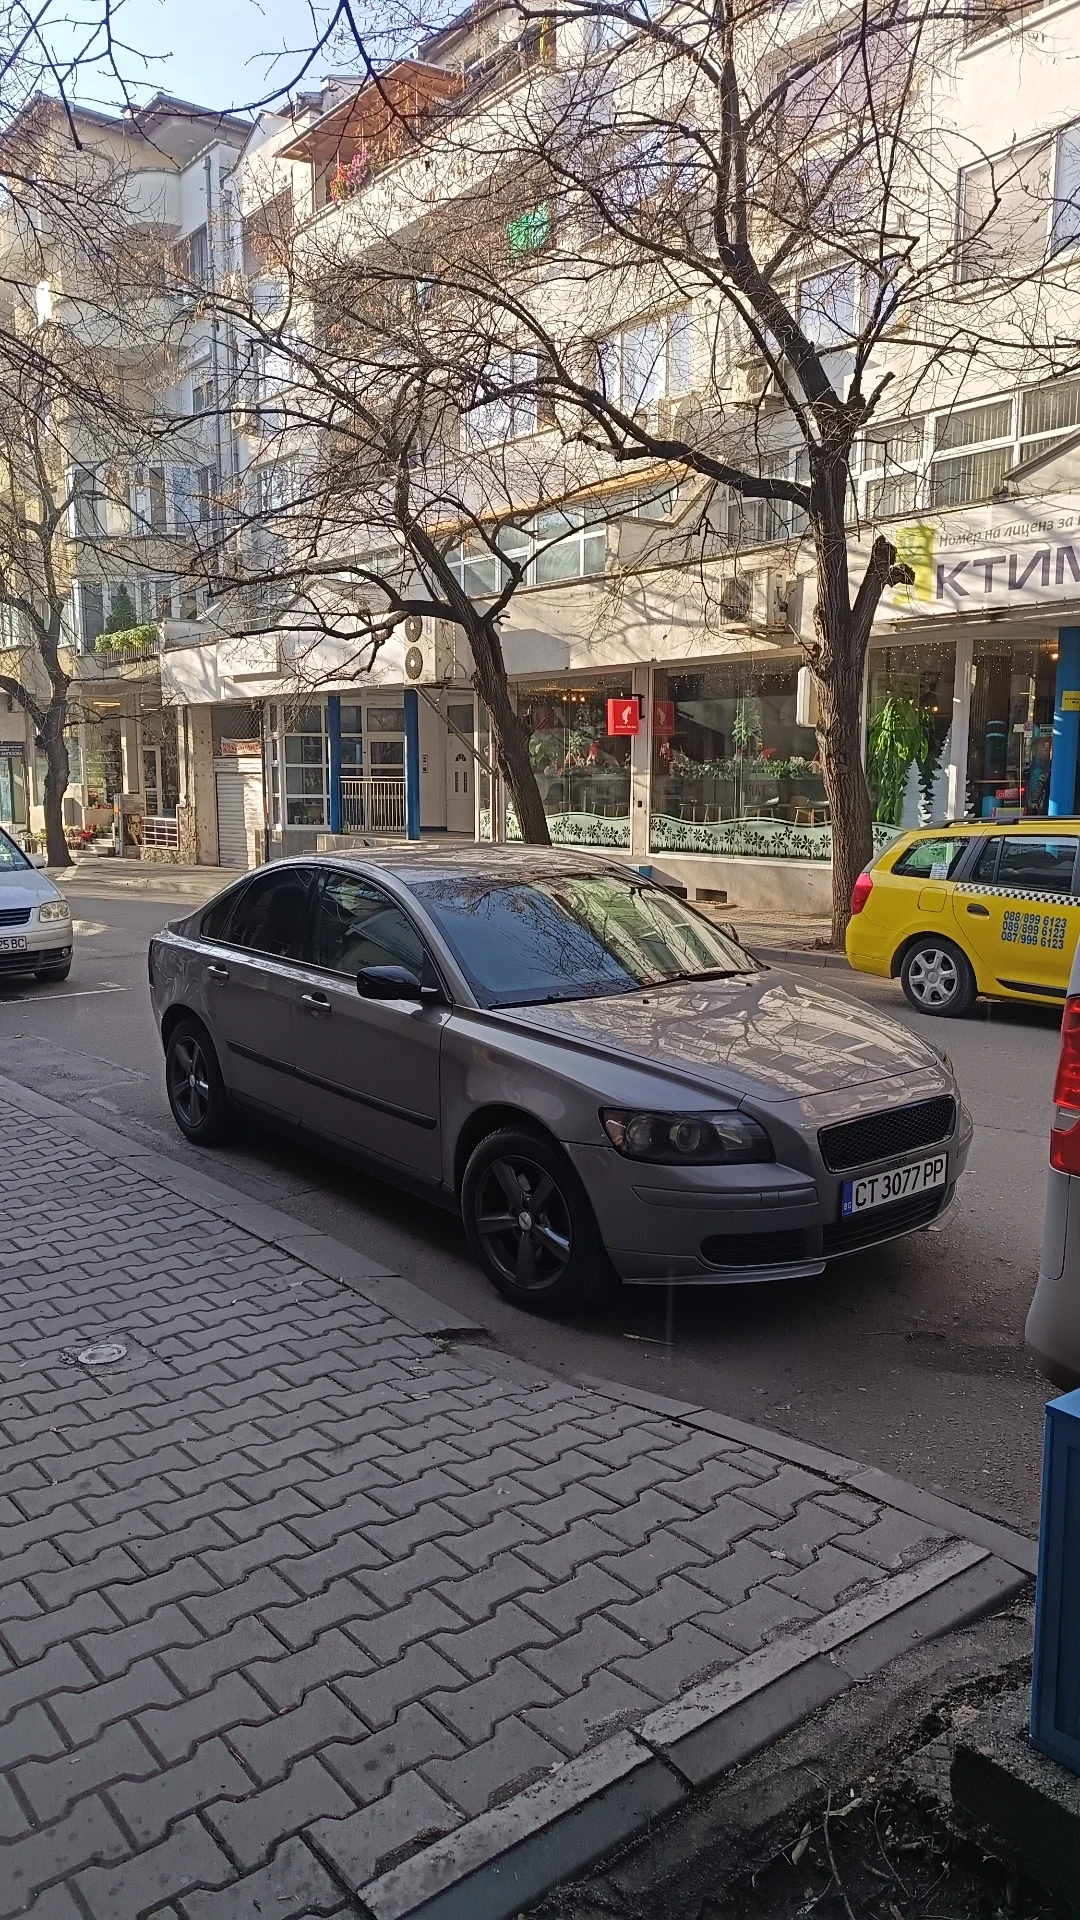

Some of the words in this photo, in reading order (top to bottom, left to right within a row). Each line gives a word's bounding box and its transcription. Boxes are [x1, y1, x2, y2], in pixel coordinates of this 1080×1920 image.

[939, 531, 981, 548] Номер
[985, 528, 1001, 541] на
[1003, 519, 1054, 537] лиценз
[1058, 516, 1074, 529] за
[1003, 910, 1041, 925] 088/899
[1043, 916, 1067, 929] 6123
[1002, 920, 1039, 935] 089/899
[1041, 926, 1065, 939] 6123
[11, 938, 25, 949] BC
[1001, 931, 1038, 945] 087/999
[1040, 937, 1064, 949] 6123
[855, 1177, 879, 1207] CT
[881, 1165, 921, 1199] 3077
[923, 1158, 944, 1186] PP
[843, 1201, 852, 1211] BG
